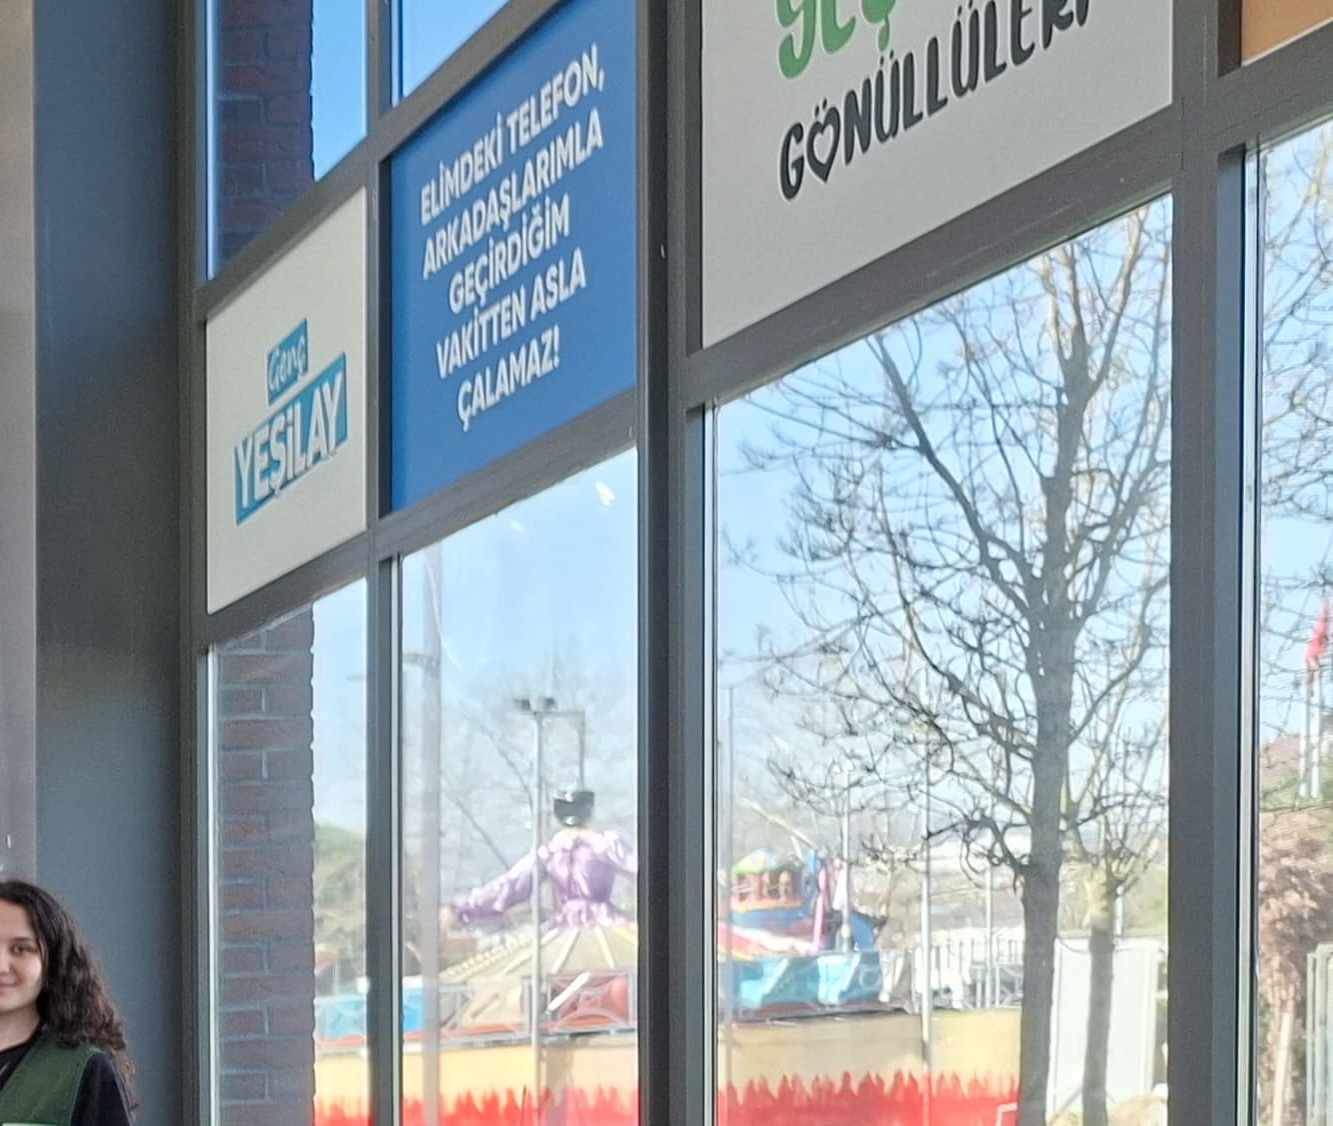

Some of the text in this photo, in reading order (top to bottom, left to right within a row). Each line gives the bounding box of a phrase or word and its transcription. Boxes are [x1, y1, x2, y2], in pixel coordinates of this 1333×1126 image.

[420, 42, 606, 227] ELİMDEKİ TELEFON,
[422, 107, 603, 281] ARKADAŞLARIMLA
[436, 246, 587, 380] VAKİTTEN ASLA
[449, 194, 571, 315] GEÇİRDİĞİM
[268, 334, 307, 393] Genç
[457, 325, 561, 432] ÇALAMAZ!
[236, 370, 344, 510] YEŞİLAY
